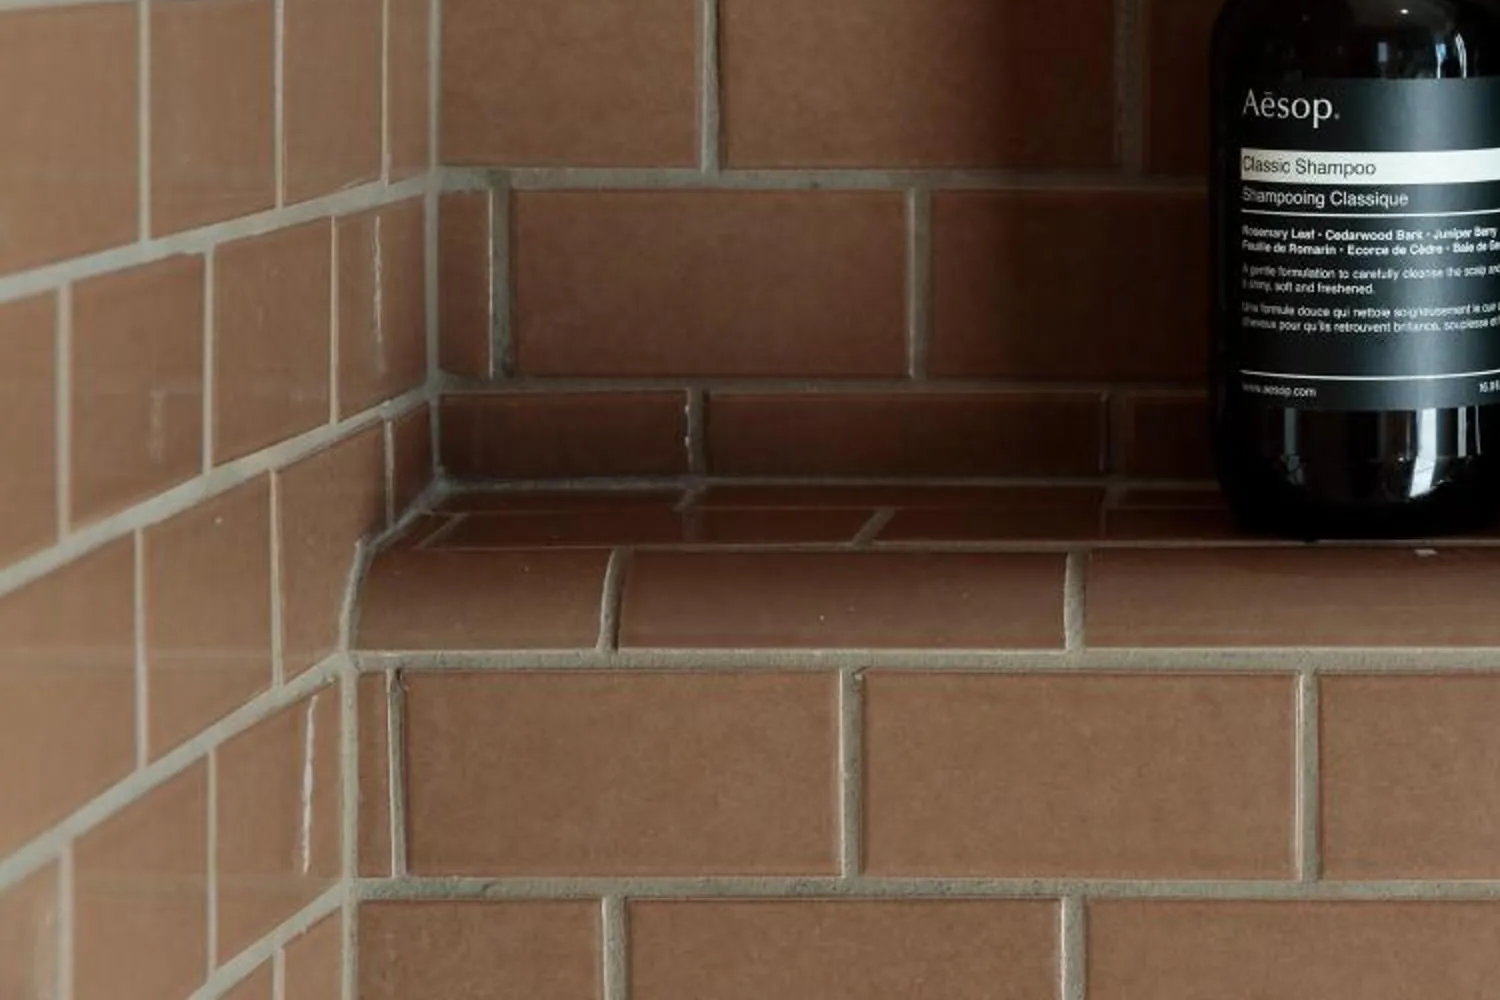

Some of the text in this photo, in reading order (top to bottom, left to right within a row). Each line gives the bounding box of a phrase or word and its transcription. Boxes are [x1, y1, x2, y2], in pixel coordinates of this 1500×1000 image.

[1242, 88, 1341, 130] Aēsop.
[1243, 155, 1377, 178] Classic Shampoo
[1241, 187, 1409, 209] Shampooing Classique
[1325, 228, 1393, 241] Cedarwood
[1396, 229, 1424, 240] Bark
[1433, 228, 1473, 241] Juniper
